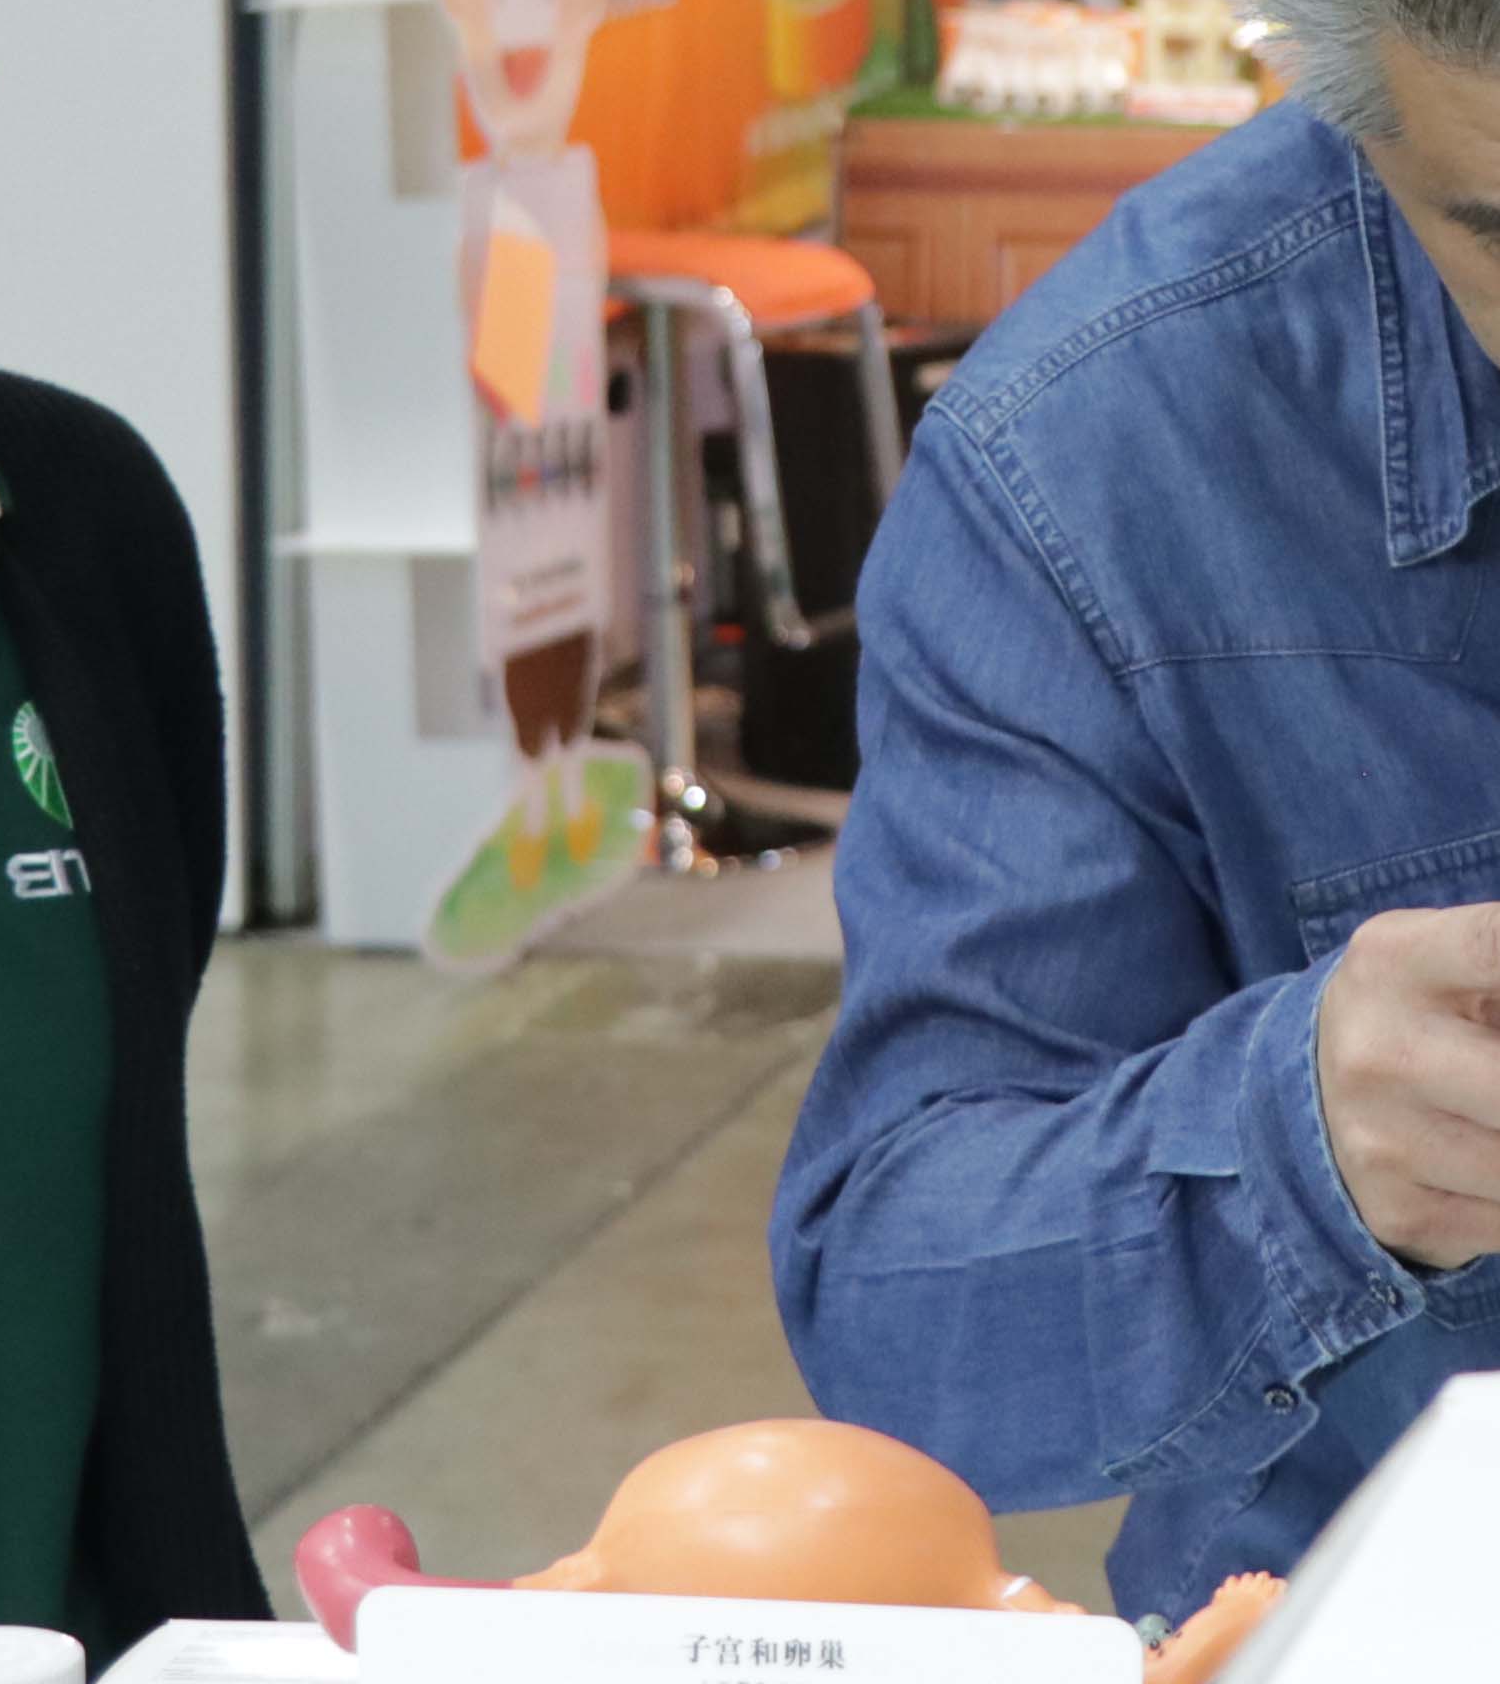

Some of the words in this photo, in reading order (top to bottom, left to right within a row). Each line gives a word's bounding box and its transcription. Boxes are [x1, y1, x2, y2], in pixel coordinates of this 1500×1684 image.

[680, 1632, 846, 1670] 子宫和卵巢
